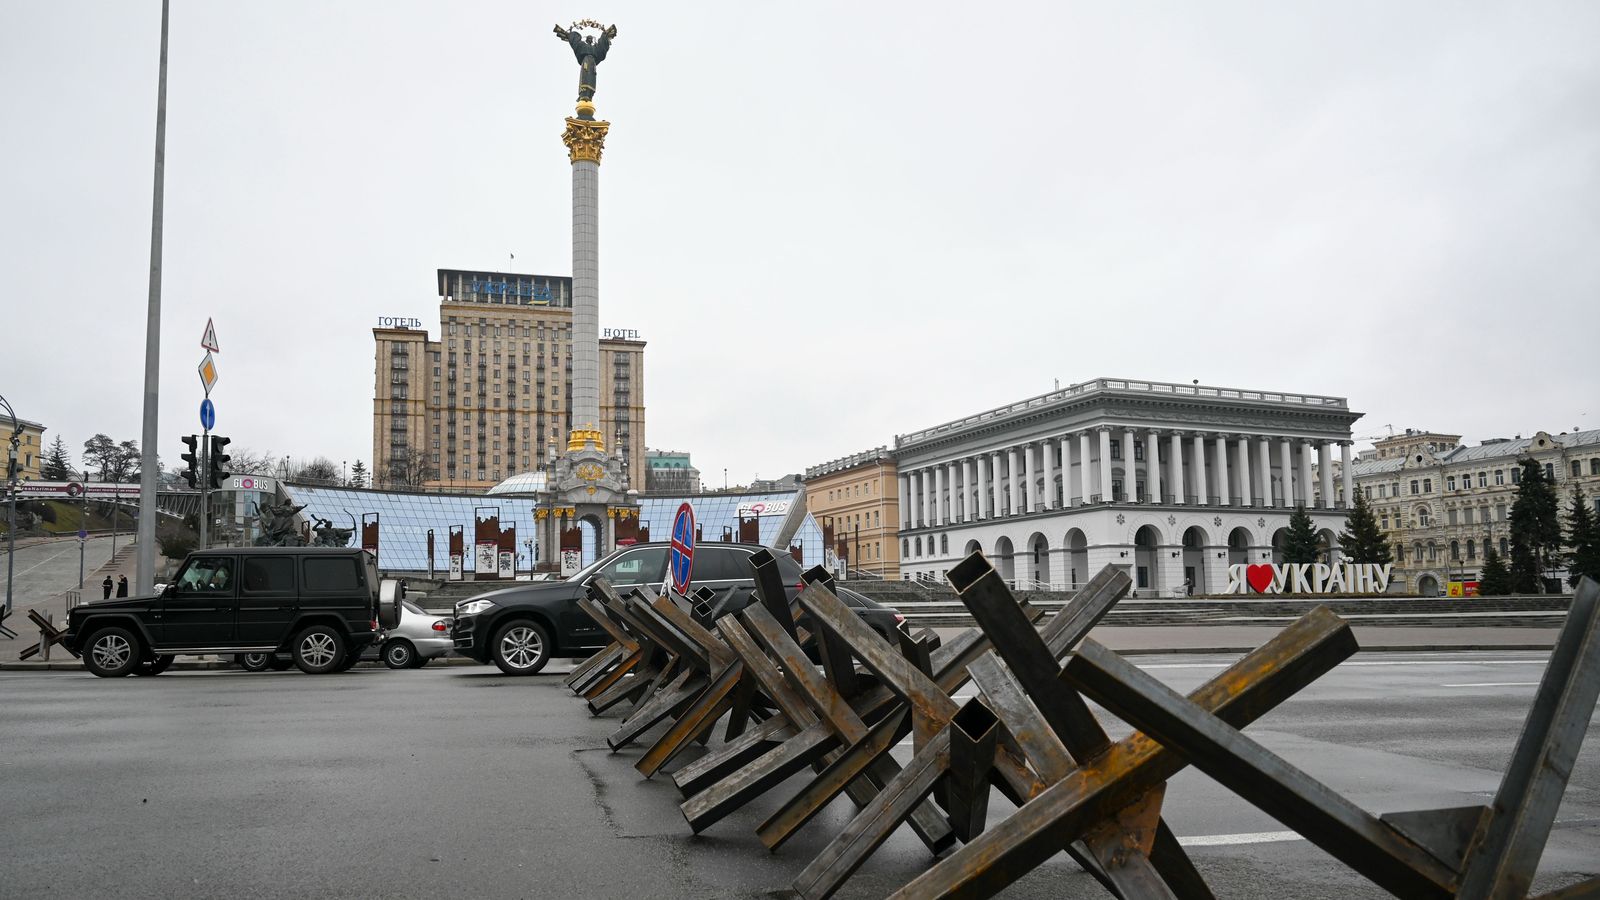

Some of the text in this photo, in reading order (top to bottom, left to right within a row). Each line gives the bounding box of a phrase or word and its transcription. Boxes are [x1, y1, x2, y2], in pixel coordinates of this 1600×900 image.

[378, 316, 422, 328] ГОТЕЛЬ
[604, 327, 641, 338] HOTEL
[233, 478, 268, 490] GLOBUS
[740, 501, 787, 514] GLOBUS
[1224, 556, 1392, 594] Я УКРАЇНУ
